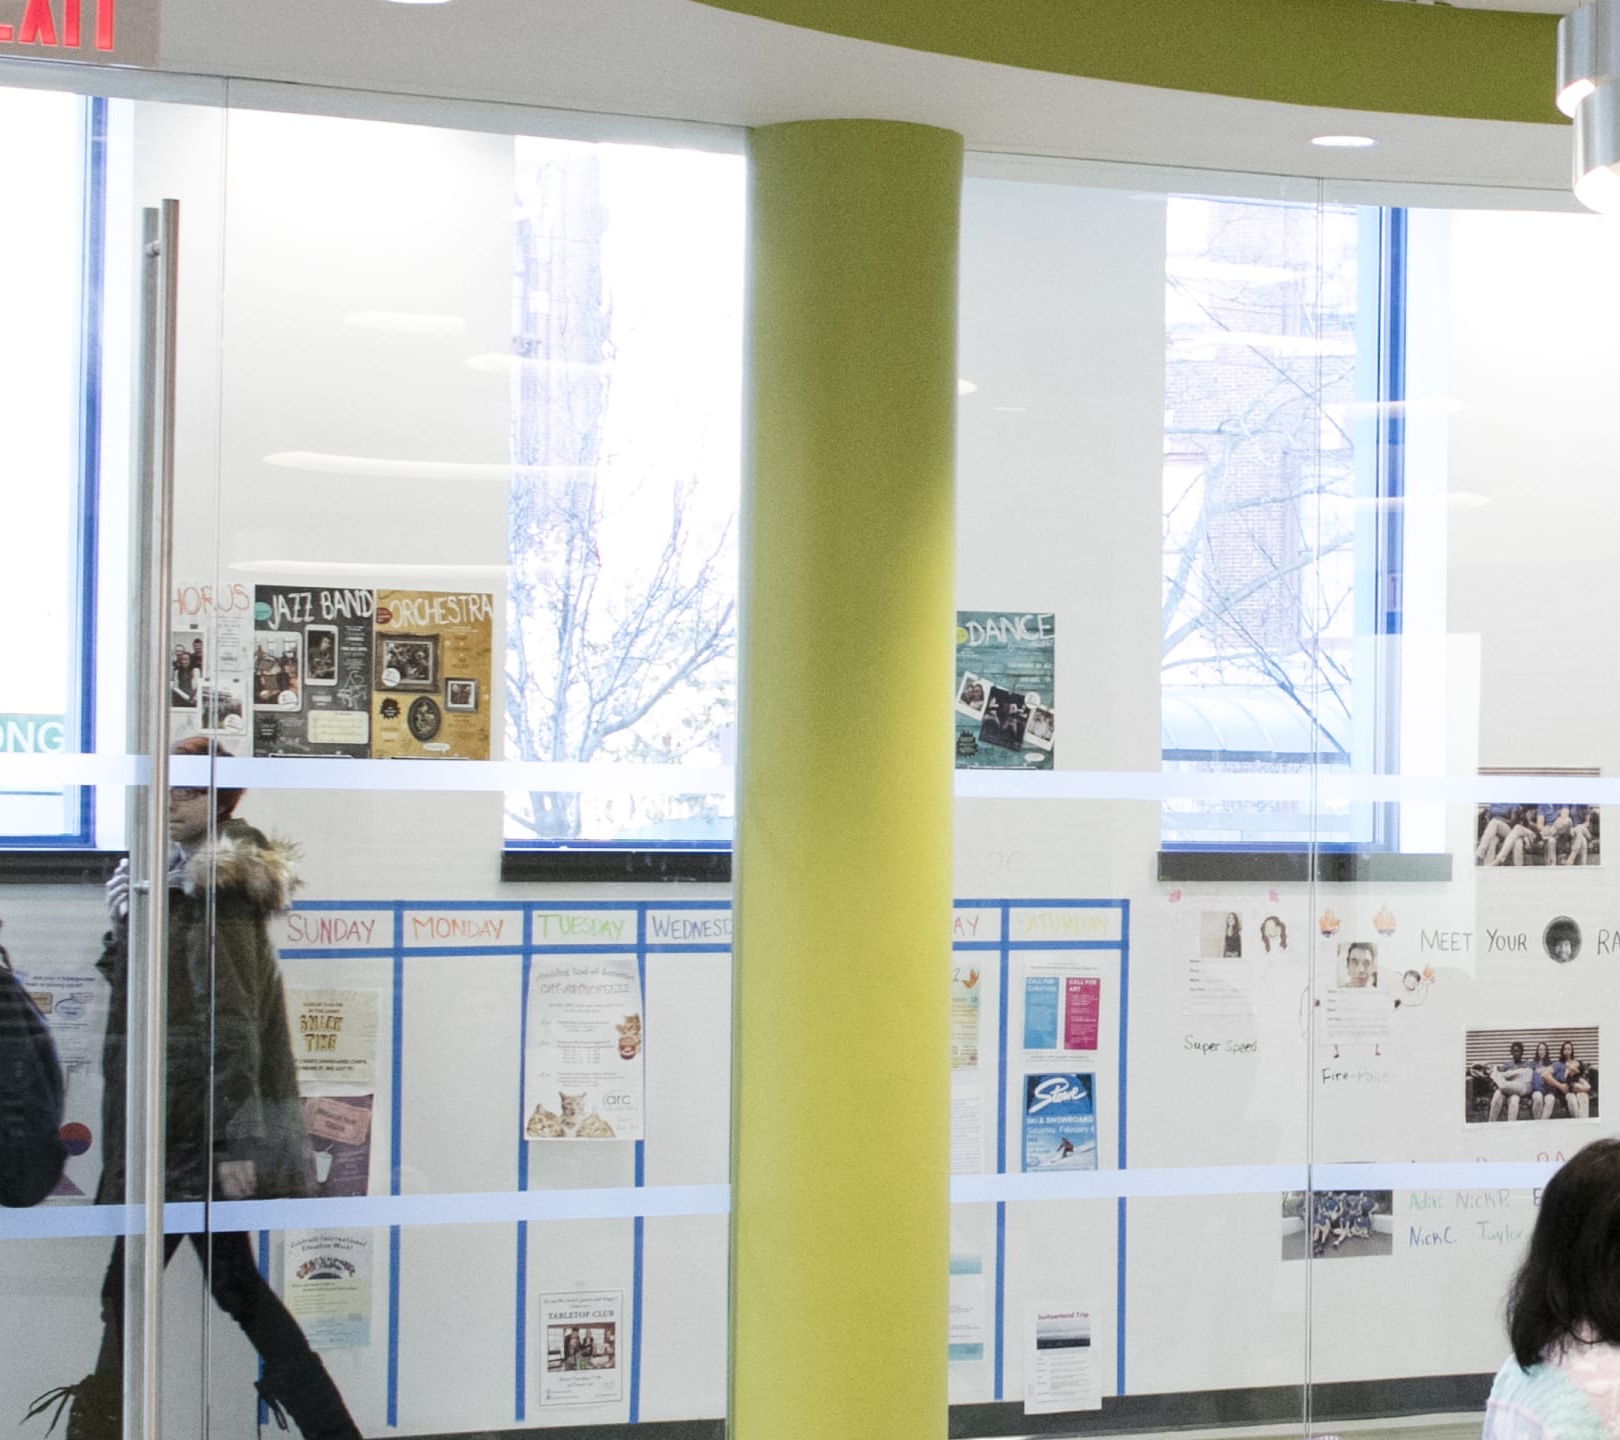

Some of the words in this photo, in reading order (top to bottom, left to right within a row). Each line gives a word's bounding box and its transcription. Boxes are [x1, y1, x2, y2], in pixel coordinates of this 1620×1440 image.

[267, 592, 315, 631] JAZZ
[319, 589, 374, 621] BAND
[390, 594, 493, 628] ORCHESTRA
[965, 613, 1055, 647] DANCE
[286, 913, 376, 944] SUNDAY
[411, 915, 505, 940] MONDAY
[536, 913, 625, 940] TUESDAY
[1017, 912, 1109, 935] SATURDAY
[1420, 928, 1474, 953] MEET
[1485, 927, 1528, 953] YOUR
[1184, 1034, 1221, 1055] Super
[605, 1094, 631, 1106] arc
[547, 1311, 590, 1320] TABLETOP
[591, 1310, 615, 1318] CLUB
